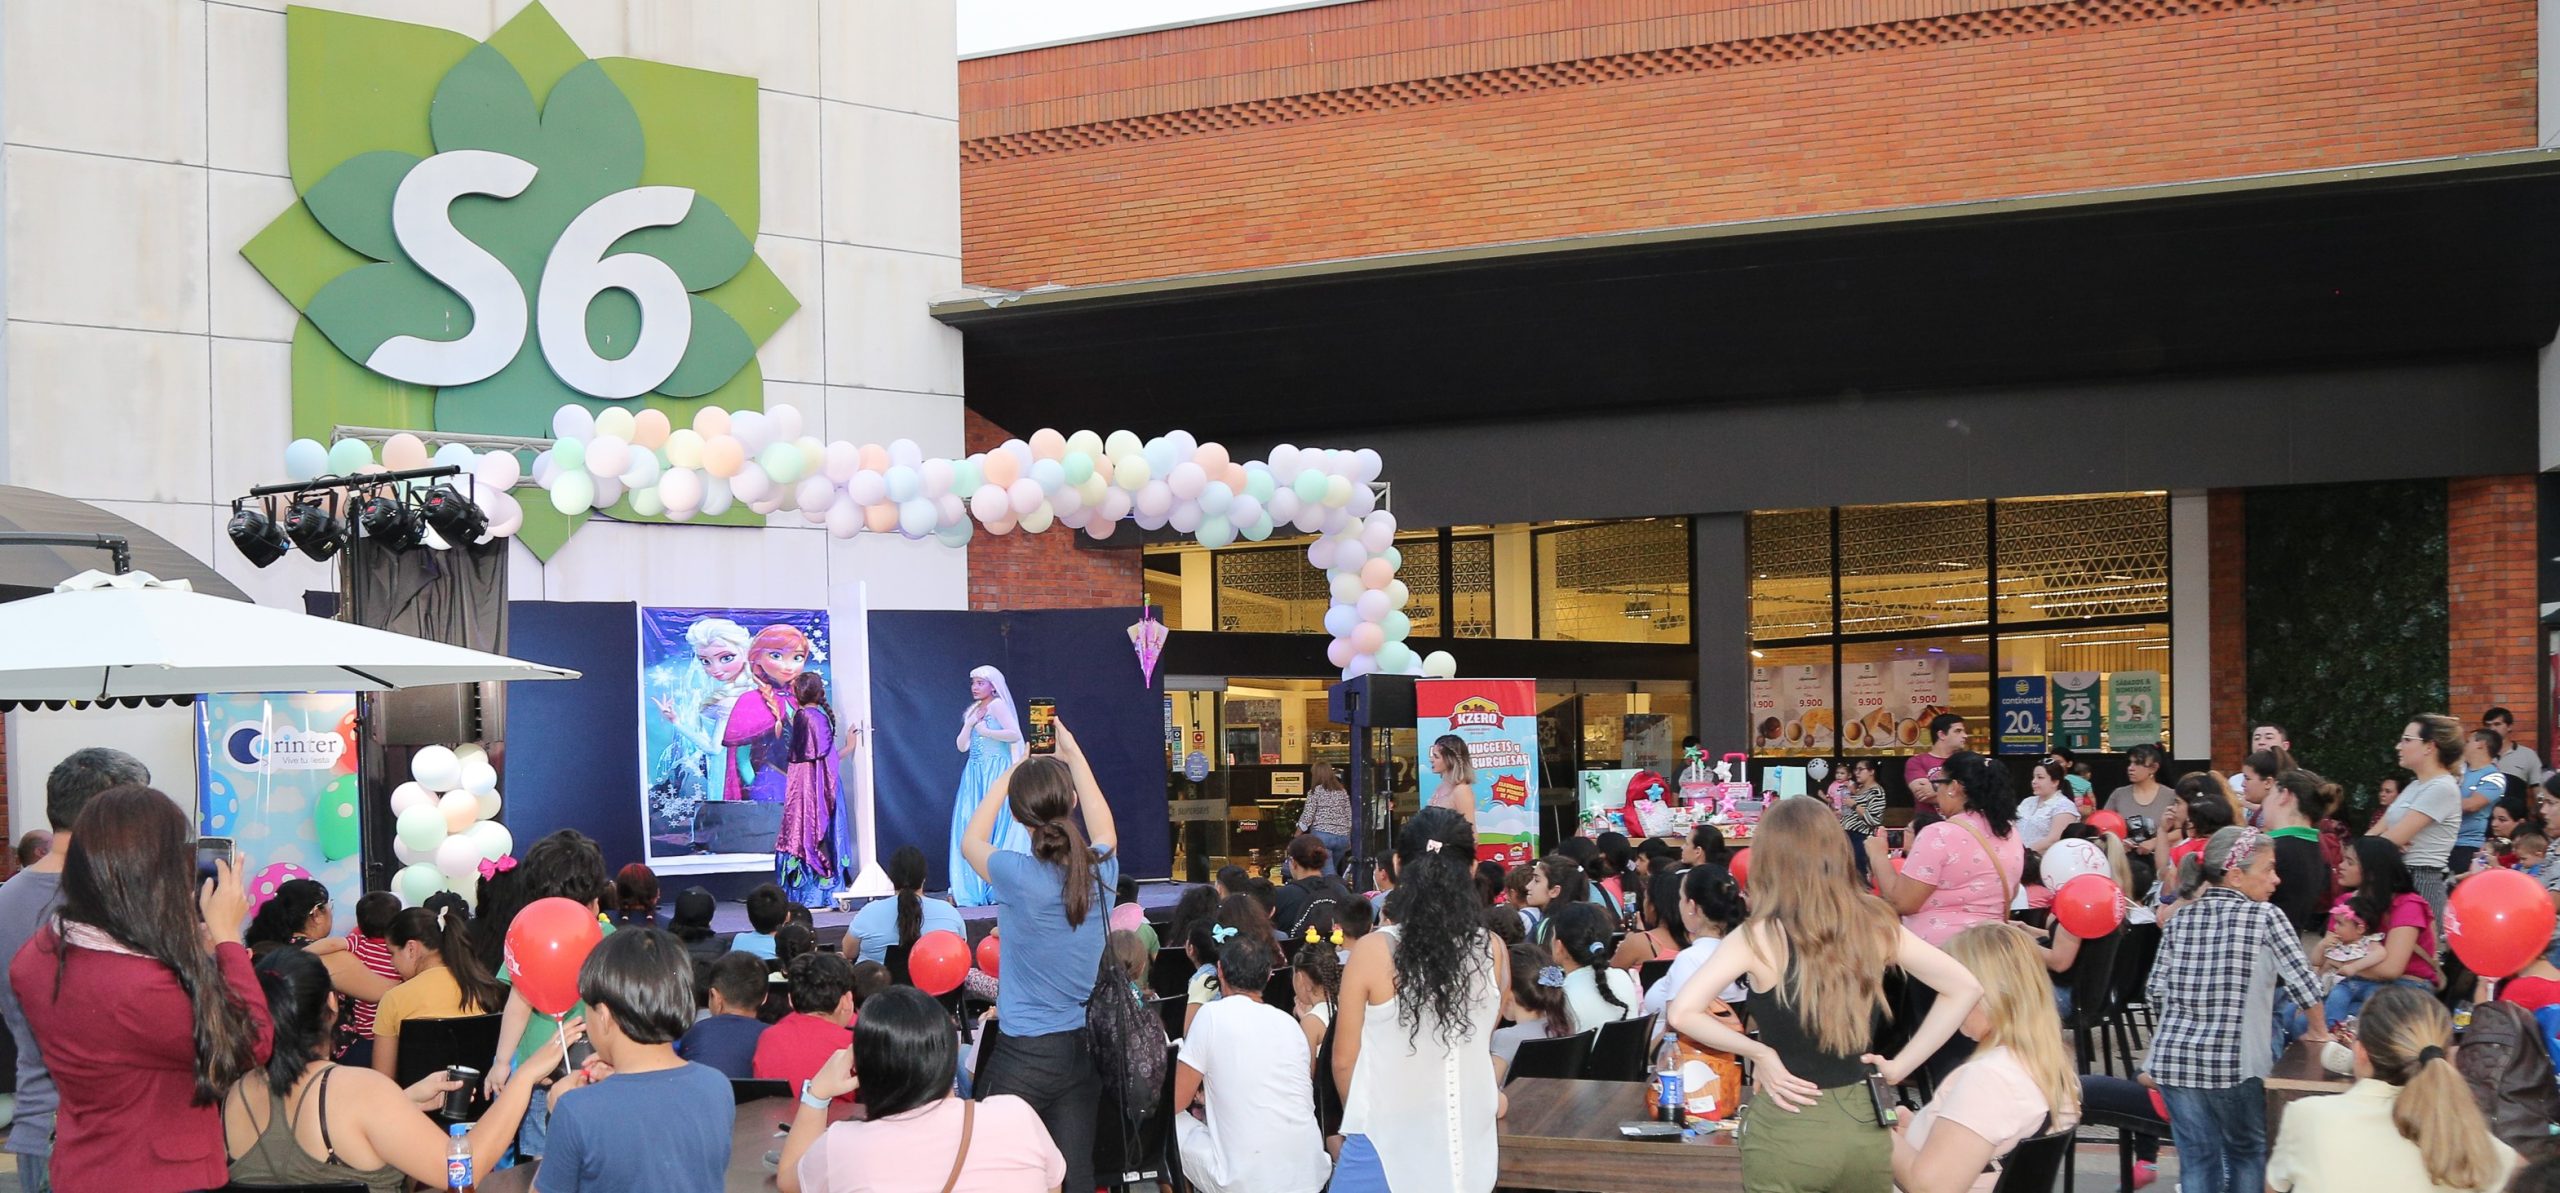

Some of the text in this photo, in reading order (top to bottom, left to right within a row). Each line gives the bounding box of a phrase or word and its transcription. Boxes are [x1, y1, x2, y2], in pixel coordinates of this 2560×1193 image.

[365, 149, 695, 399] S6
[1799, 699, 1822, 707] 9.900
[1858, 697, 1883, 706] 9.900
[1911, 695, 1937, 704] 9.900
[2002, 696, 2043, 705] continental
[1457, 712, 1498, 725] KZERO
[2005, 710, 2041, 734] 20%
[1468, 740, 1512, 755] NUGGETS
